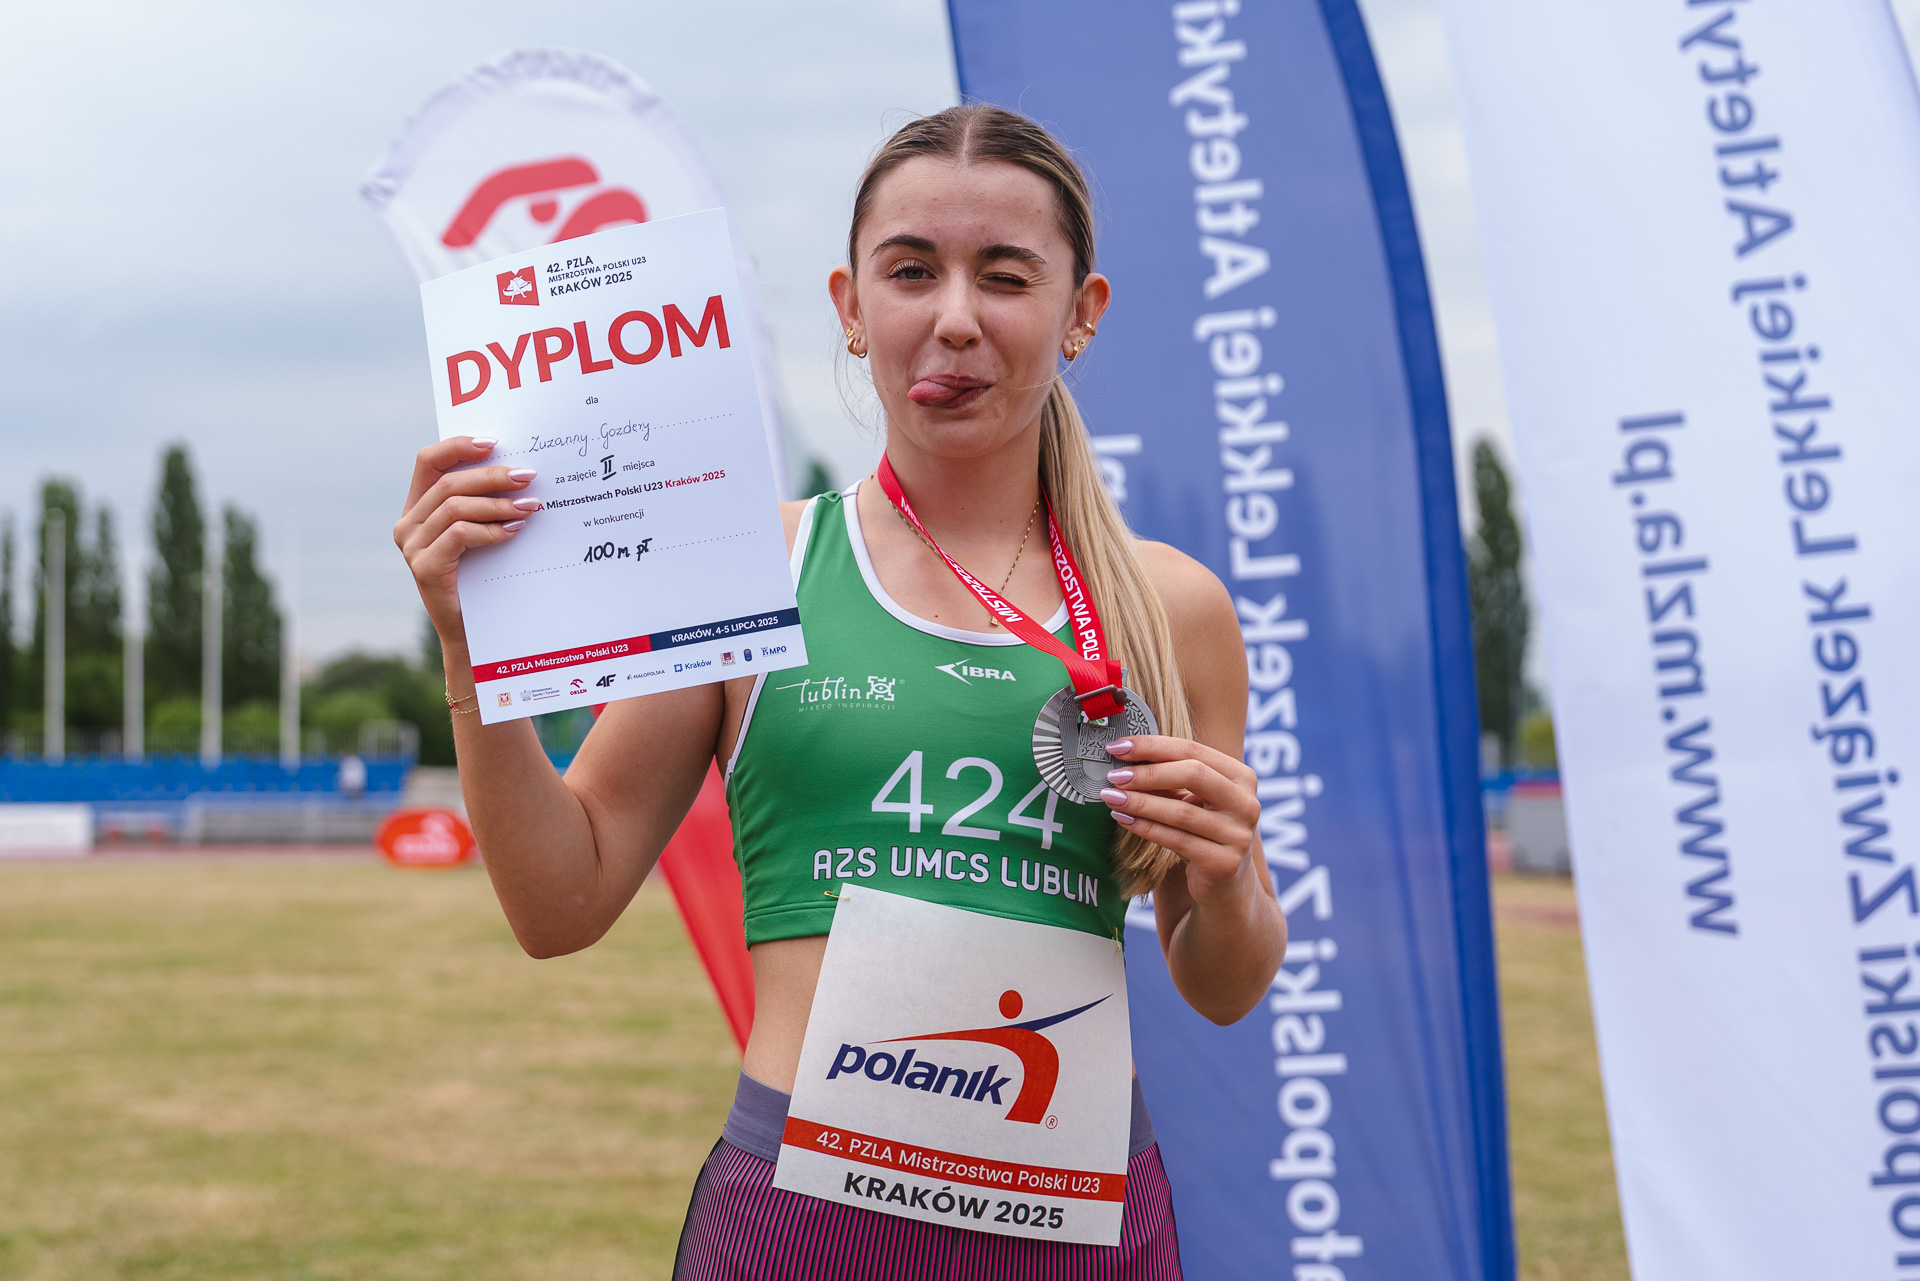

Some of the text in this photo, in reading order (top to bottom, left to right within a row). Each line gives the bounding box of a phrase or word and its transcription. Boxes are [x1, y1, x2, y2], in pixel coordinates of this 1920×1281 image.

[547, 255, 594, 274] 42. PZLA
[548, 256, 647, 283] MISTRZOSTWA POLSKI U23
[550, 270, 633, 297] KRAKÓW 2025
[446, 295, 731, 407] DYPLOM
[585, 396, 599, 405] dla
[529, 434, 588, 457] Zuzanny
[555, 469, 597, 484] za zajęcie
[600, 454, 617, 481] II
[622, 459, 656, 473] miejsca
[546, 490, 613, 510] Mistrzostwach
[615, 484, 642, 498] Polski
[644, 481, 664, 492] U23
[665, 474, 700, 489] Kraków
[702, 469, 726, 482] 2025
[583, 509, 645, 528] w konkurencji
[583, 541, 616, 563] 100
[617, 546, 631, 560] m
[671, 616, 779, 643] KRAKÓW, 4-5 LIPCA 2025
[496, 643, 629, 675] 42. PZLA Mistrzostwa Polski U23
[684, 659, 712, 670] Kraków
[569, 688, 588, 696] ORLEN
[596, 673, 616, 688] 4F
[799, 702, 895, 712] MIASTO INSPIRACJI
[871, 750, 1064, 850] 424
[812, 846, 1099, 908] AZS UMCS LUBLIN
[826, 1043, 1012, 1105] polanik
[816, 1131, 1101, 1194] 42. PZLA Mistrzostwa Polski U23
[843, 1171, 1064, 1229] KRAKÓW 2025
